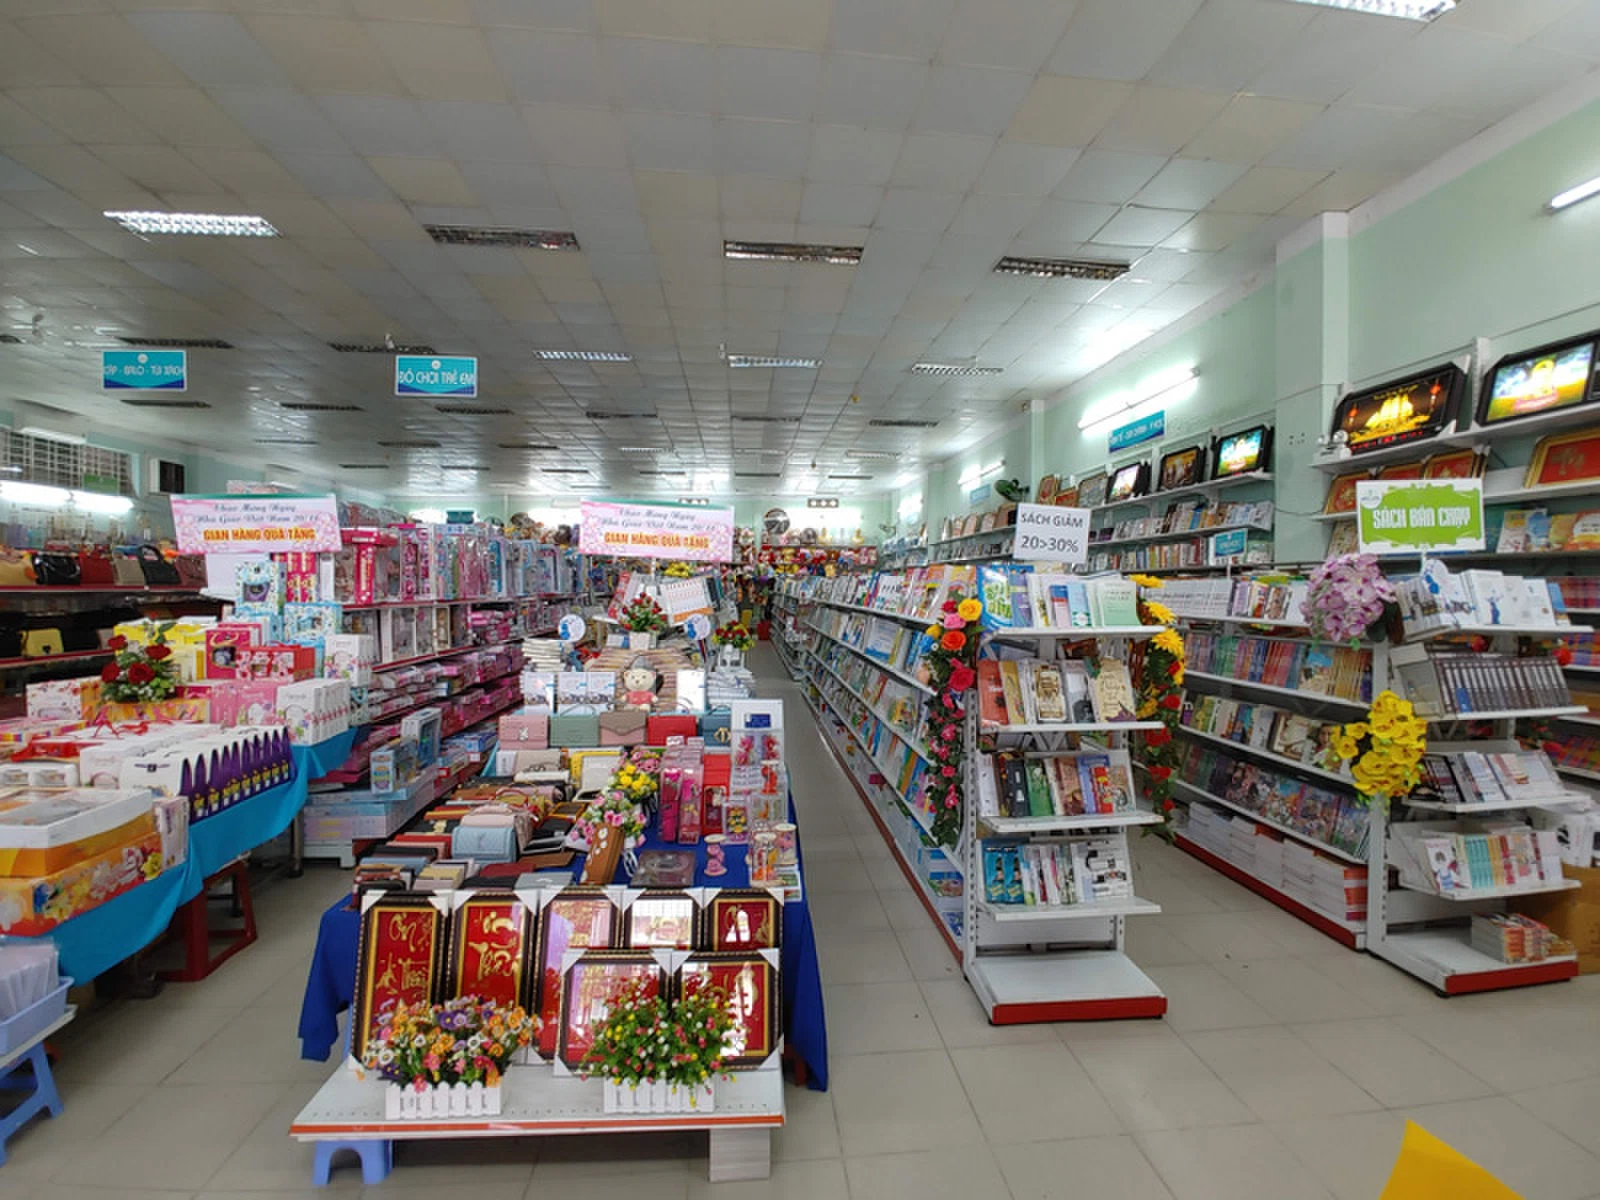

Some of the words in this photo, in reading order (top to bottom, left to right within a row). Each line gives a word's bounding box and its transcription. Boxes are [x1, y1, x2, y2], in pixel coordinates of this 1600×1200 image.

[1021, 512, 1050, 524] SÁCH
[1053, 514, 1083, 528] GIẢM
[1372, 505, 1407, 529] SÁCH
[1409, 504, 1435, 528] BÁN
[1438, 506, 1471, 529] CHẠY
[203, 529, 229, 541] GIAN
[232, 528, 261, 541] HÀNG
[265, 527, 285, 541] QUÀ
[288, 527, 316, 543] TẶNG
[604, 532, 628, 544] GIAN
[631, 532, 658, 546] HÀNG
[1020, 535, 1079, 553] 20>30%
